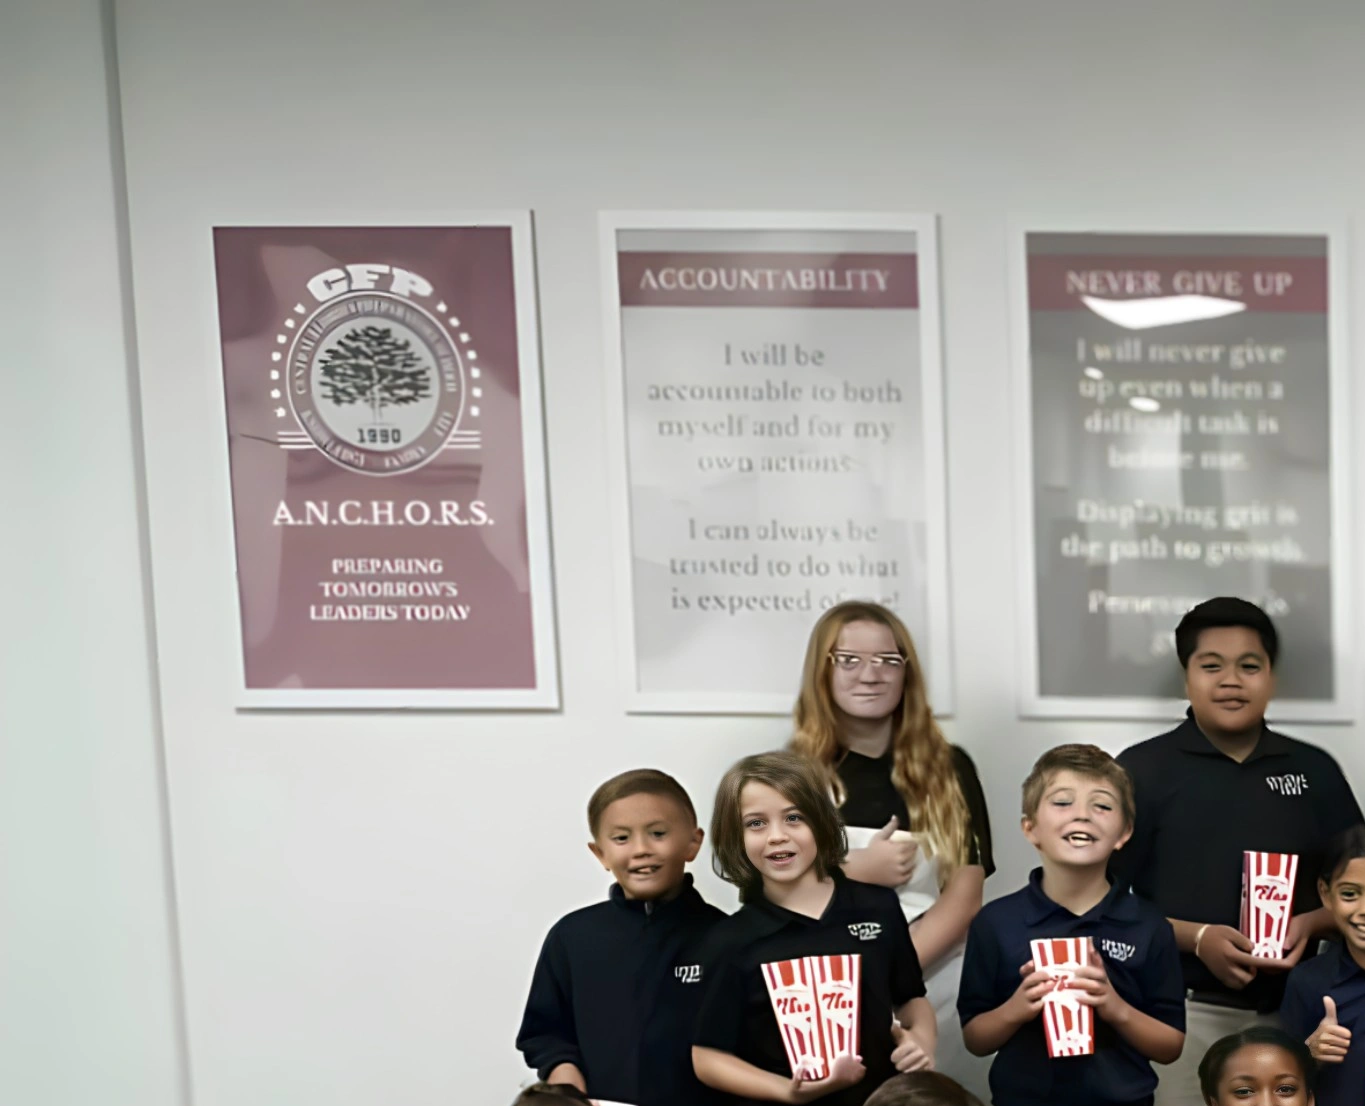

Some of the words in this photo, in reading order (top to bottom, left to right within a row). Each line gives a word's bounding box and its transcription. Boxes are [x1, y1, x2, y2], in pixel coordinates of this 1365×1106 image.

[640, 267, 890, 292] ACCOUNTABILITY
[1066, 269, 1161, 294] NEVER
[1173, 271, 1244, 296] GIVE
[1253, 272, 1293, 296] UP
[724, 343, 732, 366] I
[741, 343, 787, 366] will
[795, 342, 825, 366] be
[1077, 338, 1085, 362] I
[1093, 338, 1142, 362] will
[1149, 344, 1225, 363] never
[1229, 338, 1286, 370] give
[648, 380, 803, 402] accountable
[811, 384, 836, 402] to
[843, 381, 903, 403] both
[1079, 381, 1115, 404] up
[1119, 381, 1183, 399] even
[1189, 374, 1263, 400] when
[1268, 381, 1284, 400] a
[658, 415, 748, 442] myself
[753, 415, 799, 438] and
[808, 415, 844, 438] for
[853, 419, 895, 444] my
[1257, 411, 1279, 434] is
[357, 428, 402, 444] 1990
[698, 456, 753, 473] own
[272, 499, 495, 526] A.N.C.H.O.R.S.
[704, 524, 749, 540] can
[757, 519, 841, 545] always
[847, 519, 879, 541] be
[1174, 539, 1201, 559] to
[332, 558, 444, 575] PREPARING
[670, 554, 758, 576] trusted
[767, 560, 791, 577] to
[799, 556, 830, 577] do
[839, 556, 899, 577] what
[310, 604, 398, 621] LEADERS
[401, 604, 471, 621] TODAY
[672, 587, 690, 610] is
[698, 589, 811, 615] expected
